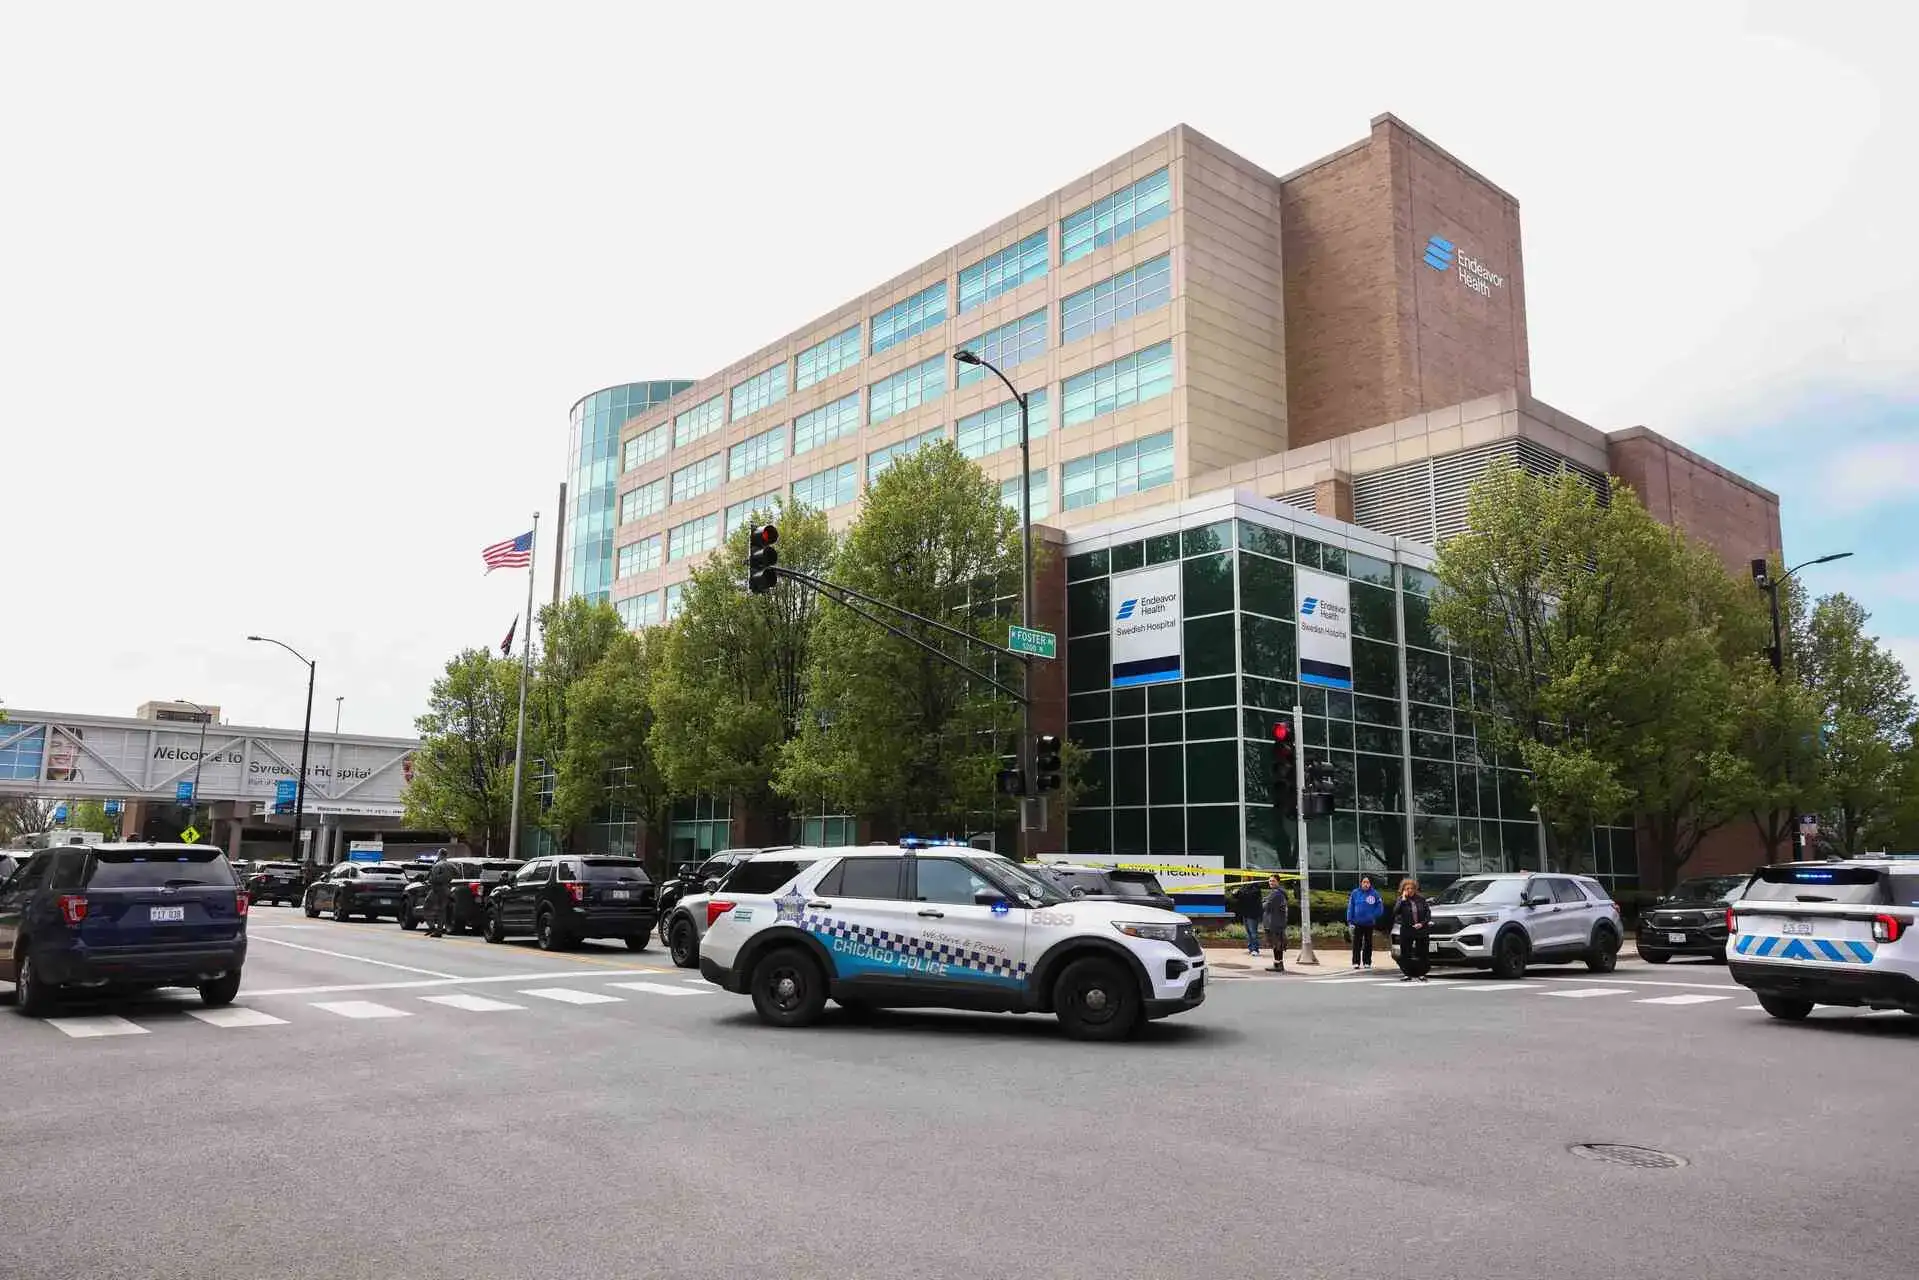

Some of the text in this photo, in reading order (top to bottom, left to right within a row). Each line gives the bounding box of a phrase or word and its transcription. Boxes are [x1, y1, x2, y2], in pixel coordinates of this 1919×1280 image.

[1458, 248, 1504, 288] Endeavor
[1459, 266, 1491, 297] Health
[1141, 594, 1176, 606] Endeavor
[1141, 604, 1166, 616] Health
[1116, 618, 1176, 636] Swedish Hospital
[1017, 630, 1046, 646] FOSTER
[228, 752, 242, 763] to
[249, 761, 311, 776] Swedh
[833, 938, 950, 977] CHICAGO POLICE
